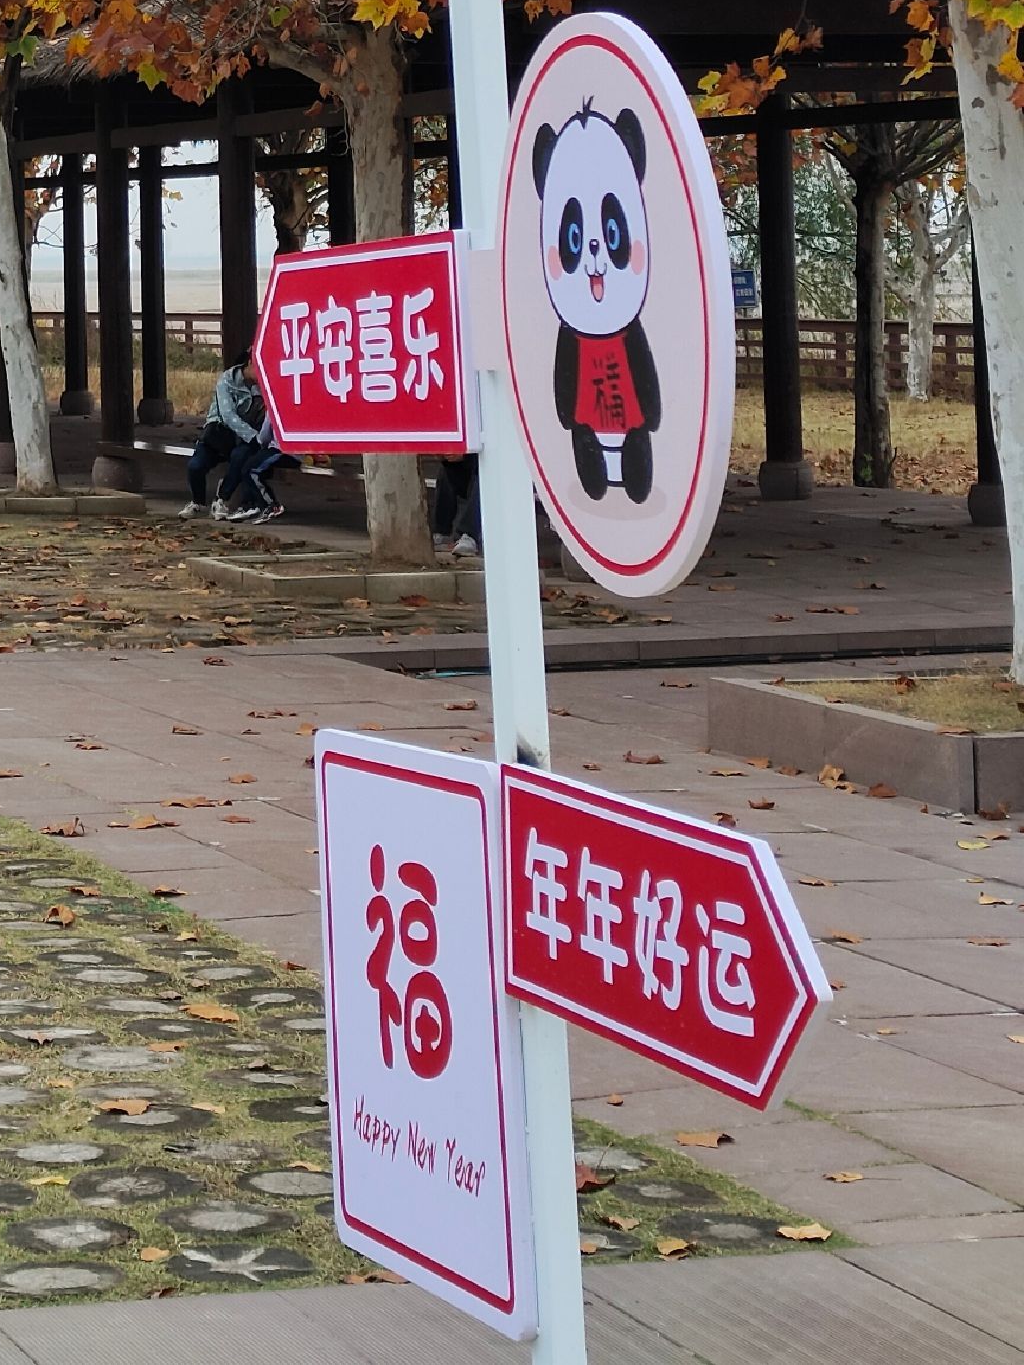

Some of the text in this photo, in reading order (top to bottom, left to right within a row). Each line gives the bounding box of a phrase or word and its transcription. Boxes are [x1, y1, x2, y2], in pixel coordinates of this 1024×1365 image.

[279, 287, 445, 405] 平安喜乐
[365, 844, 453, 1079] 福
[524, 827, 756, 1037] 年年好运
[353, 1094, 486, 1198] Happy New Year
